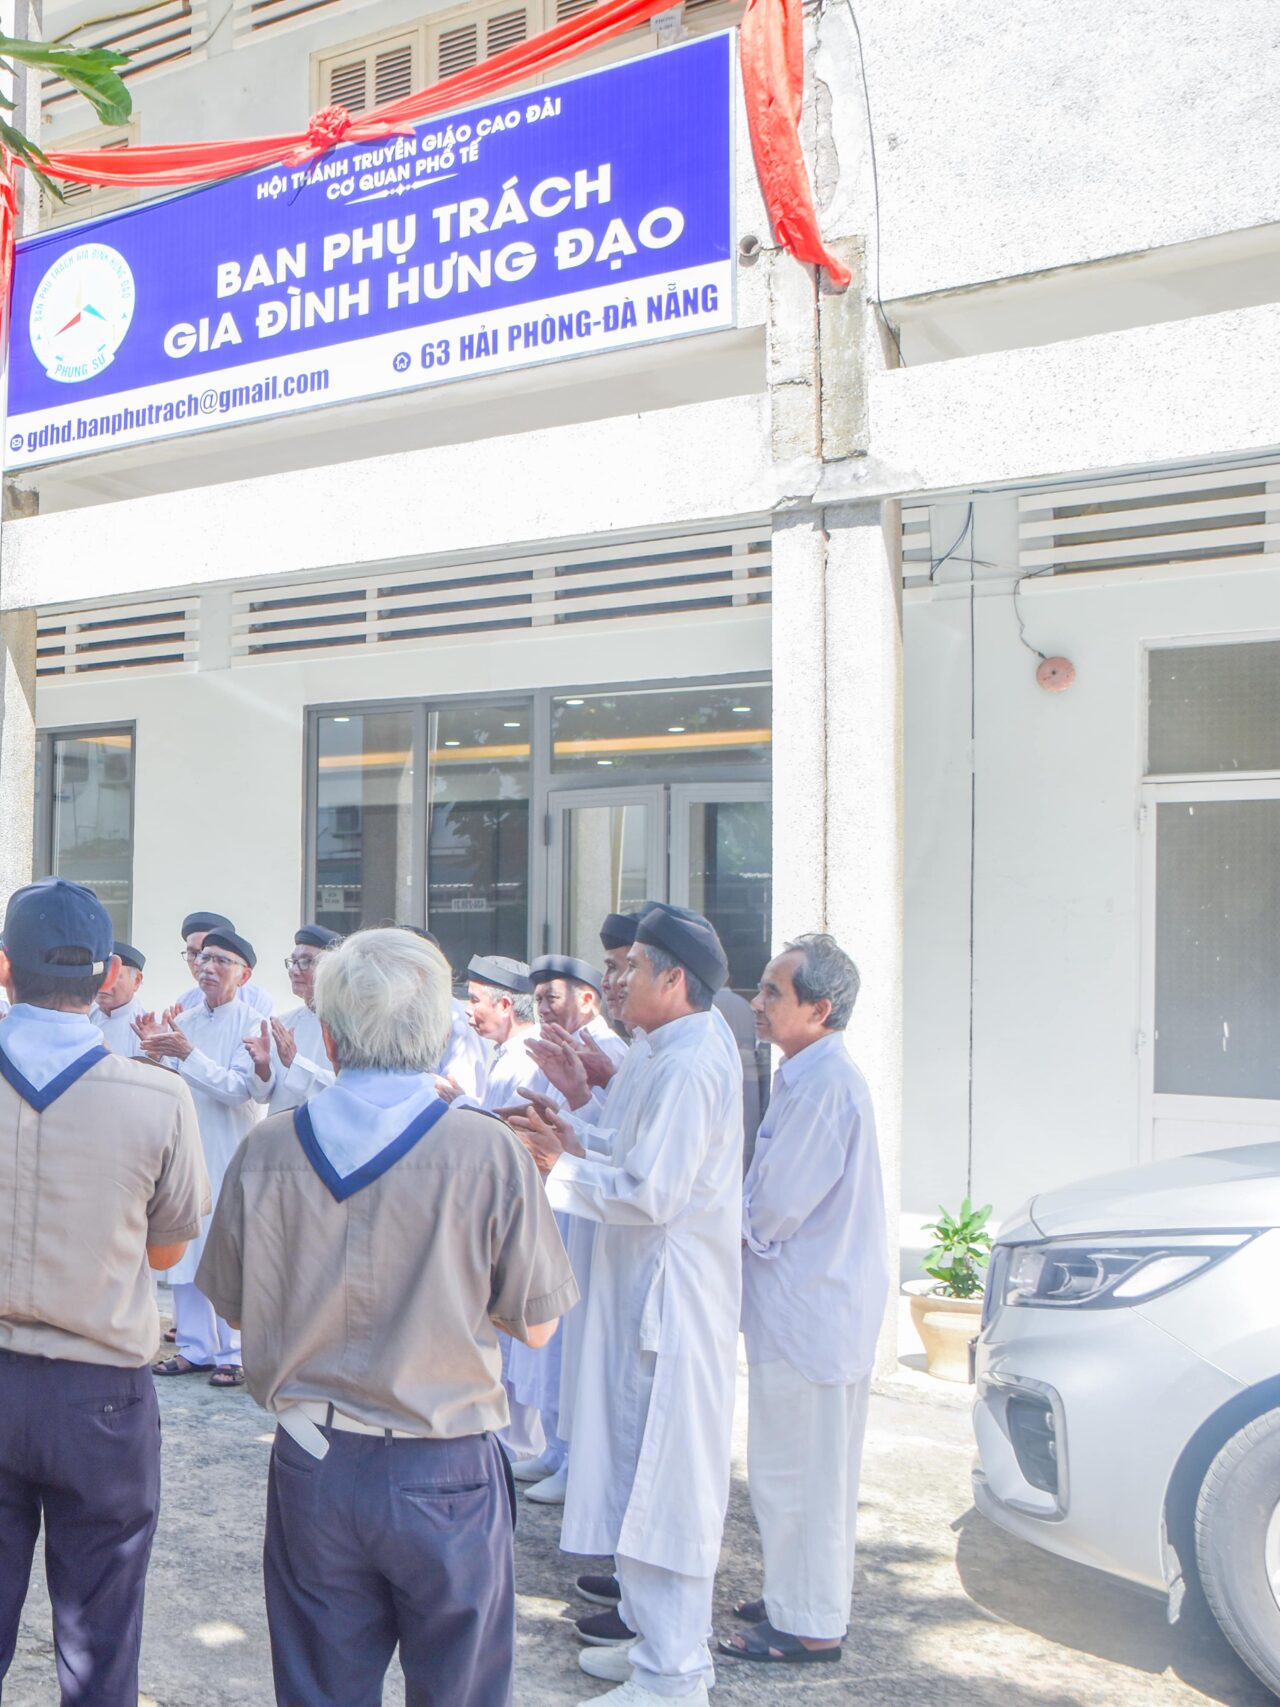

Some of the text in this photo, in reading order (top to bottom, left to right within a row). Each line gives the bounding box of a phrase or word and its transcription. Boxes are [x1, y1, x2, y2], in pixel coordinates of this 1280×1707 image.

[257, 96, 561, 199] HỘI THÁNH TRUYỀN GIÁO CAO ĐÀI
[326, 136, 482, 199] CƠ QUAN PHỔ TẾ
[217, 163, 611, 299] BAN PHỤ TRÁCH
[163, 206, 685, 359] GIA ĐÌNH HƯNG ĐẠO
[421, 283, 718, 369] 63 HẢI PHÒNG-ĐÀ NẴNG
[27, 368, 329, 453] gdhd.banphutrach@gmail.com
